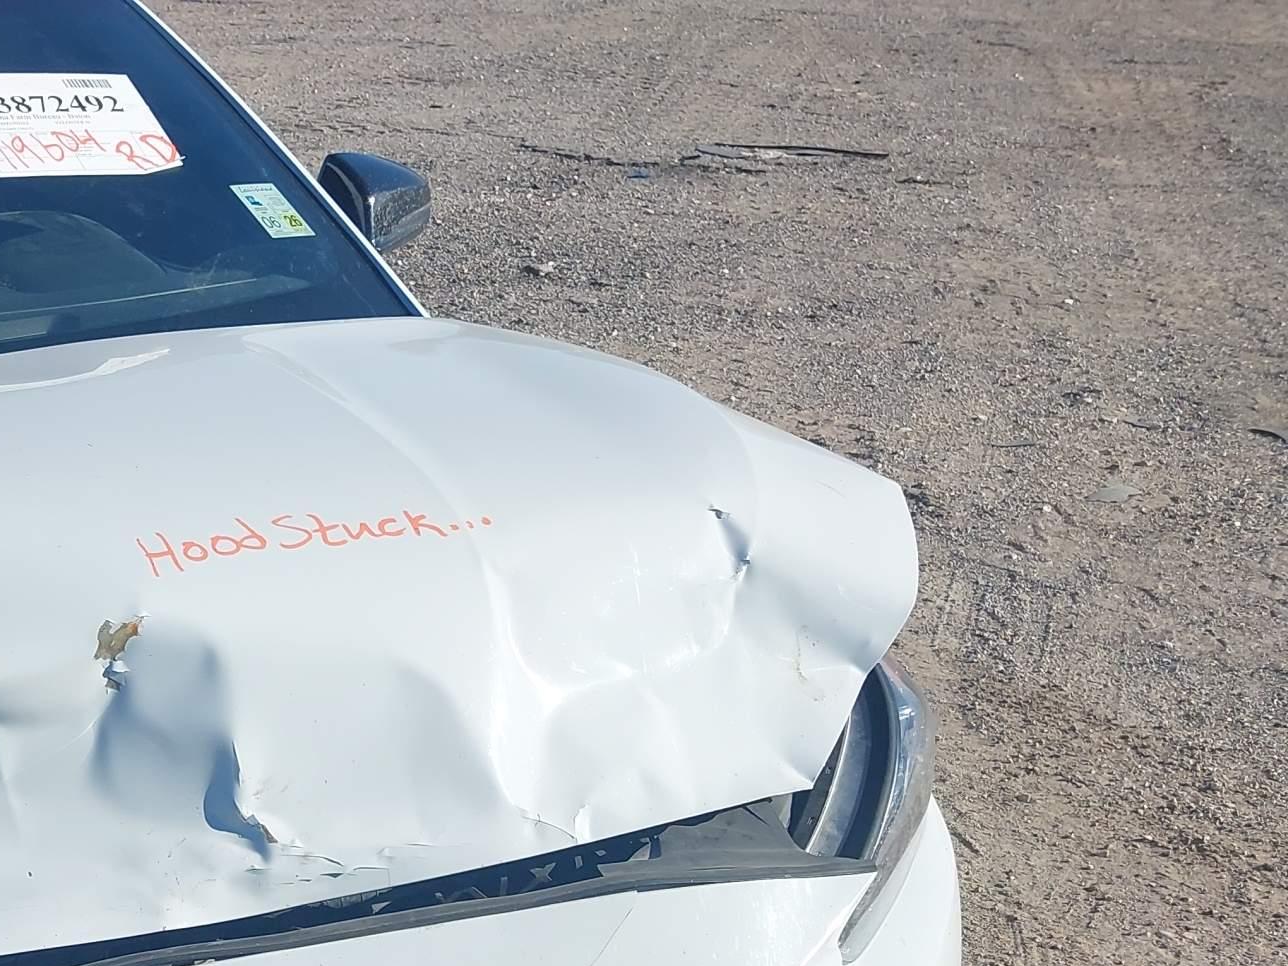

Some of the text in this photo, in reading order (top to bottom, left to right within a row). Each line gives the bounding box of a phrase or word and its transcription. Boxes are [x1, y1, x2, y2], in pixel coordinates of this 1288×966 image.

[261, 214, 303, 228] 06 26
[136, 517, 268, 577] Hood
